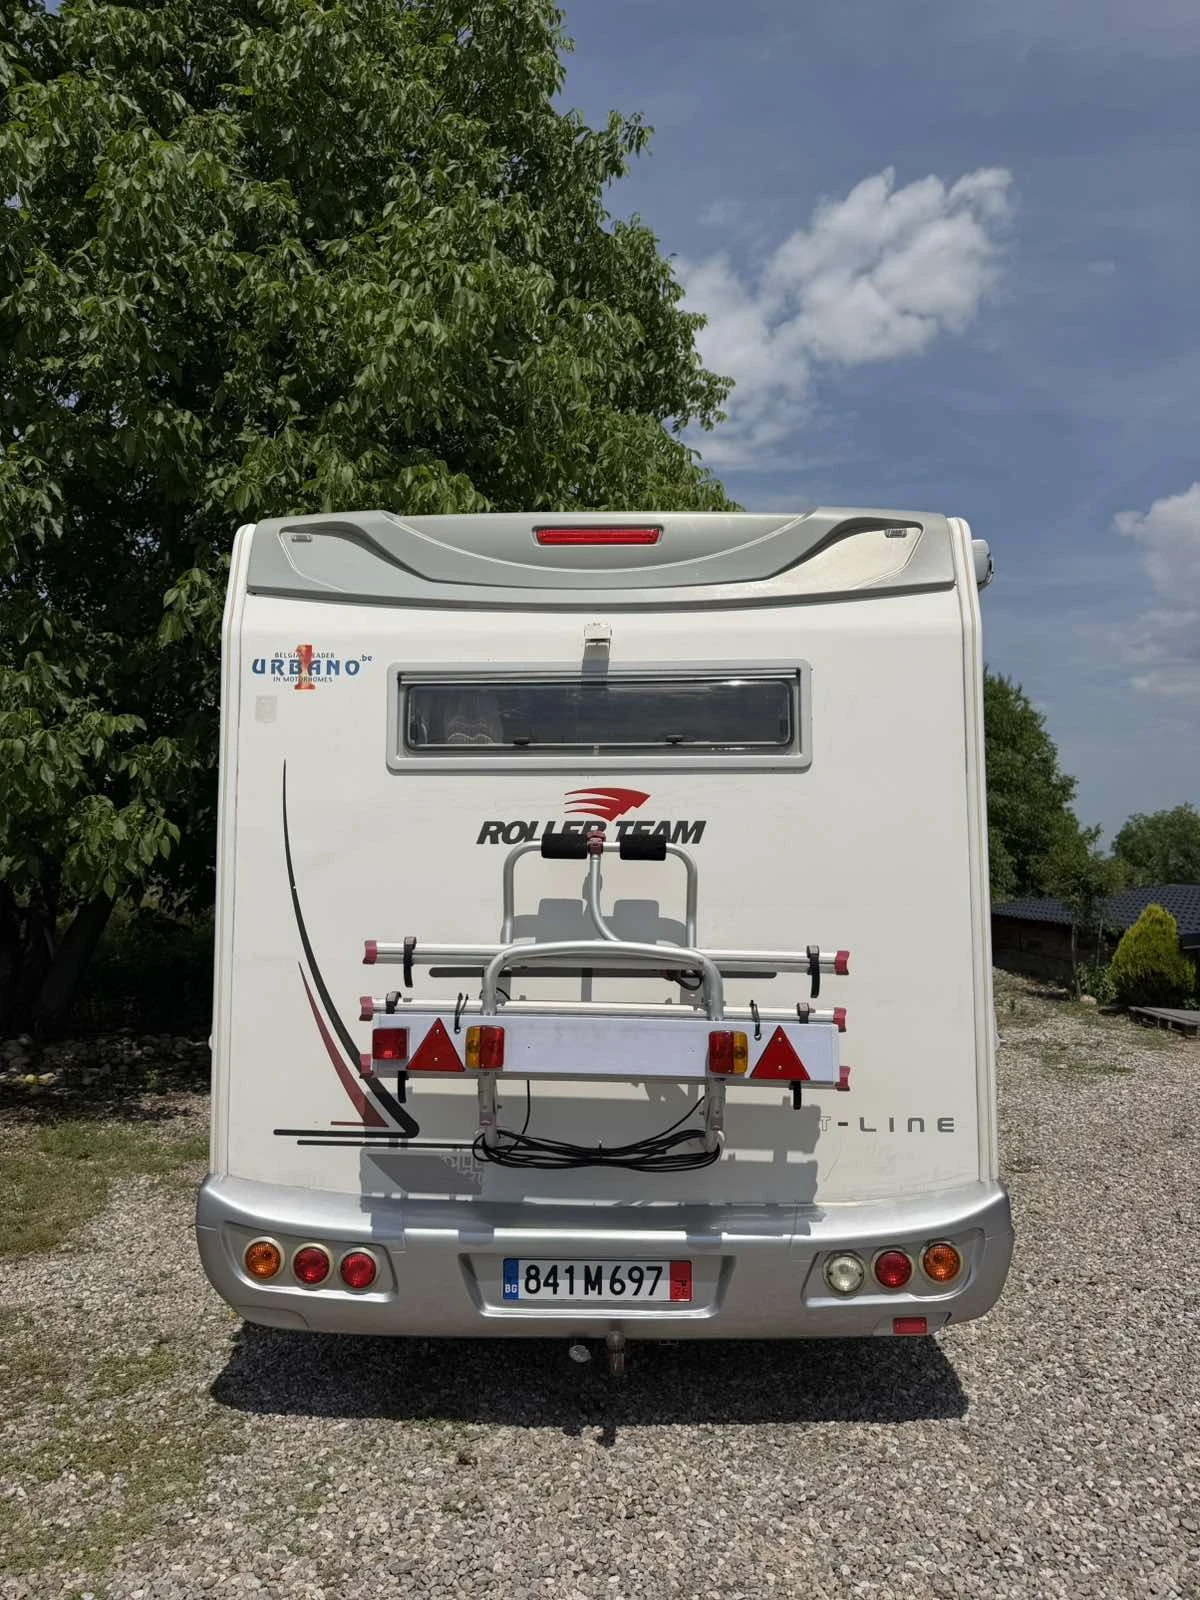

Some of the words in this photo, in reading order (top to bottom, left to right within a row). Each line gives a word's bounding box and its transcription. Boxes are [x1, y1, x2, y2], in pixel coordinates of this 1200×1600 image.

[476, 820, 607, 845] ROLLER
[615, 820, 707, 845] TEAM
[505, 1284, 517, 1293] BG
